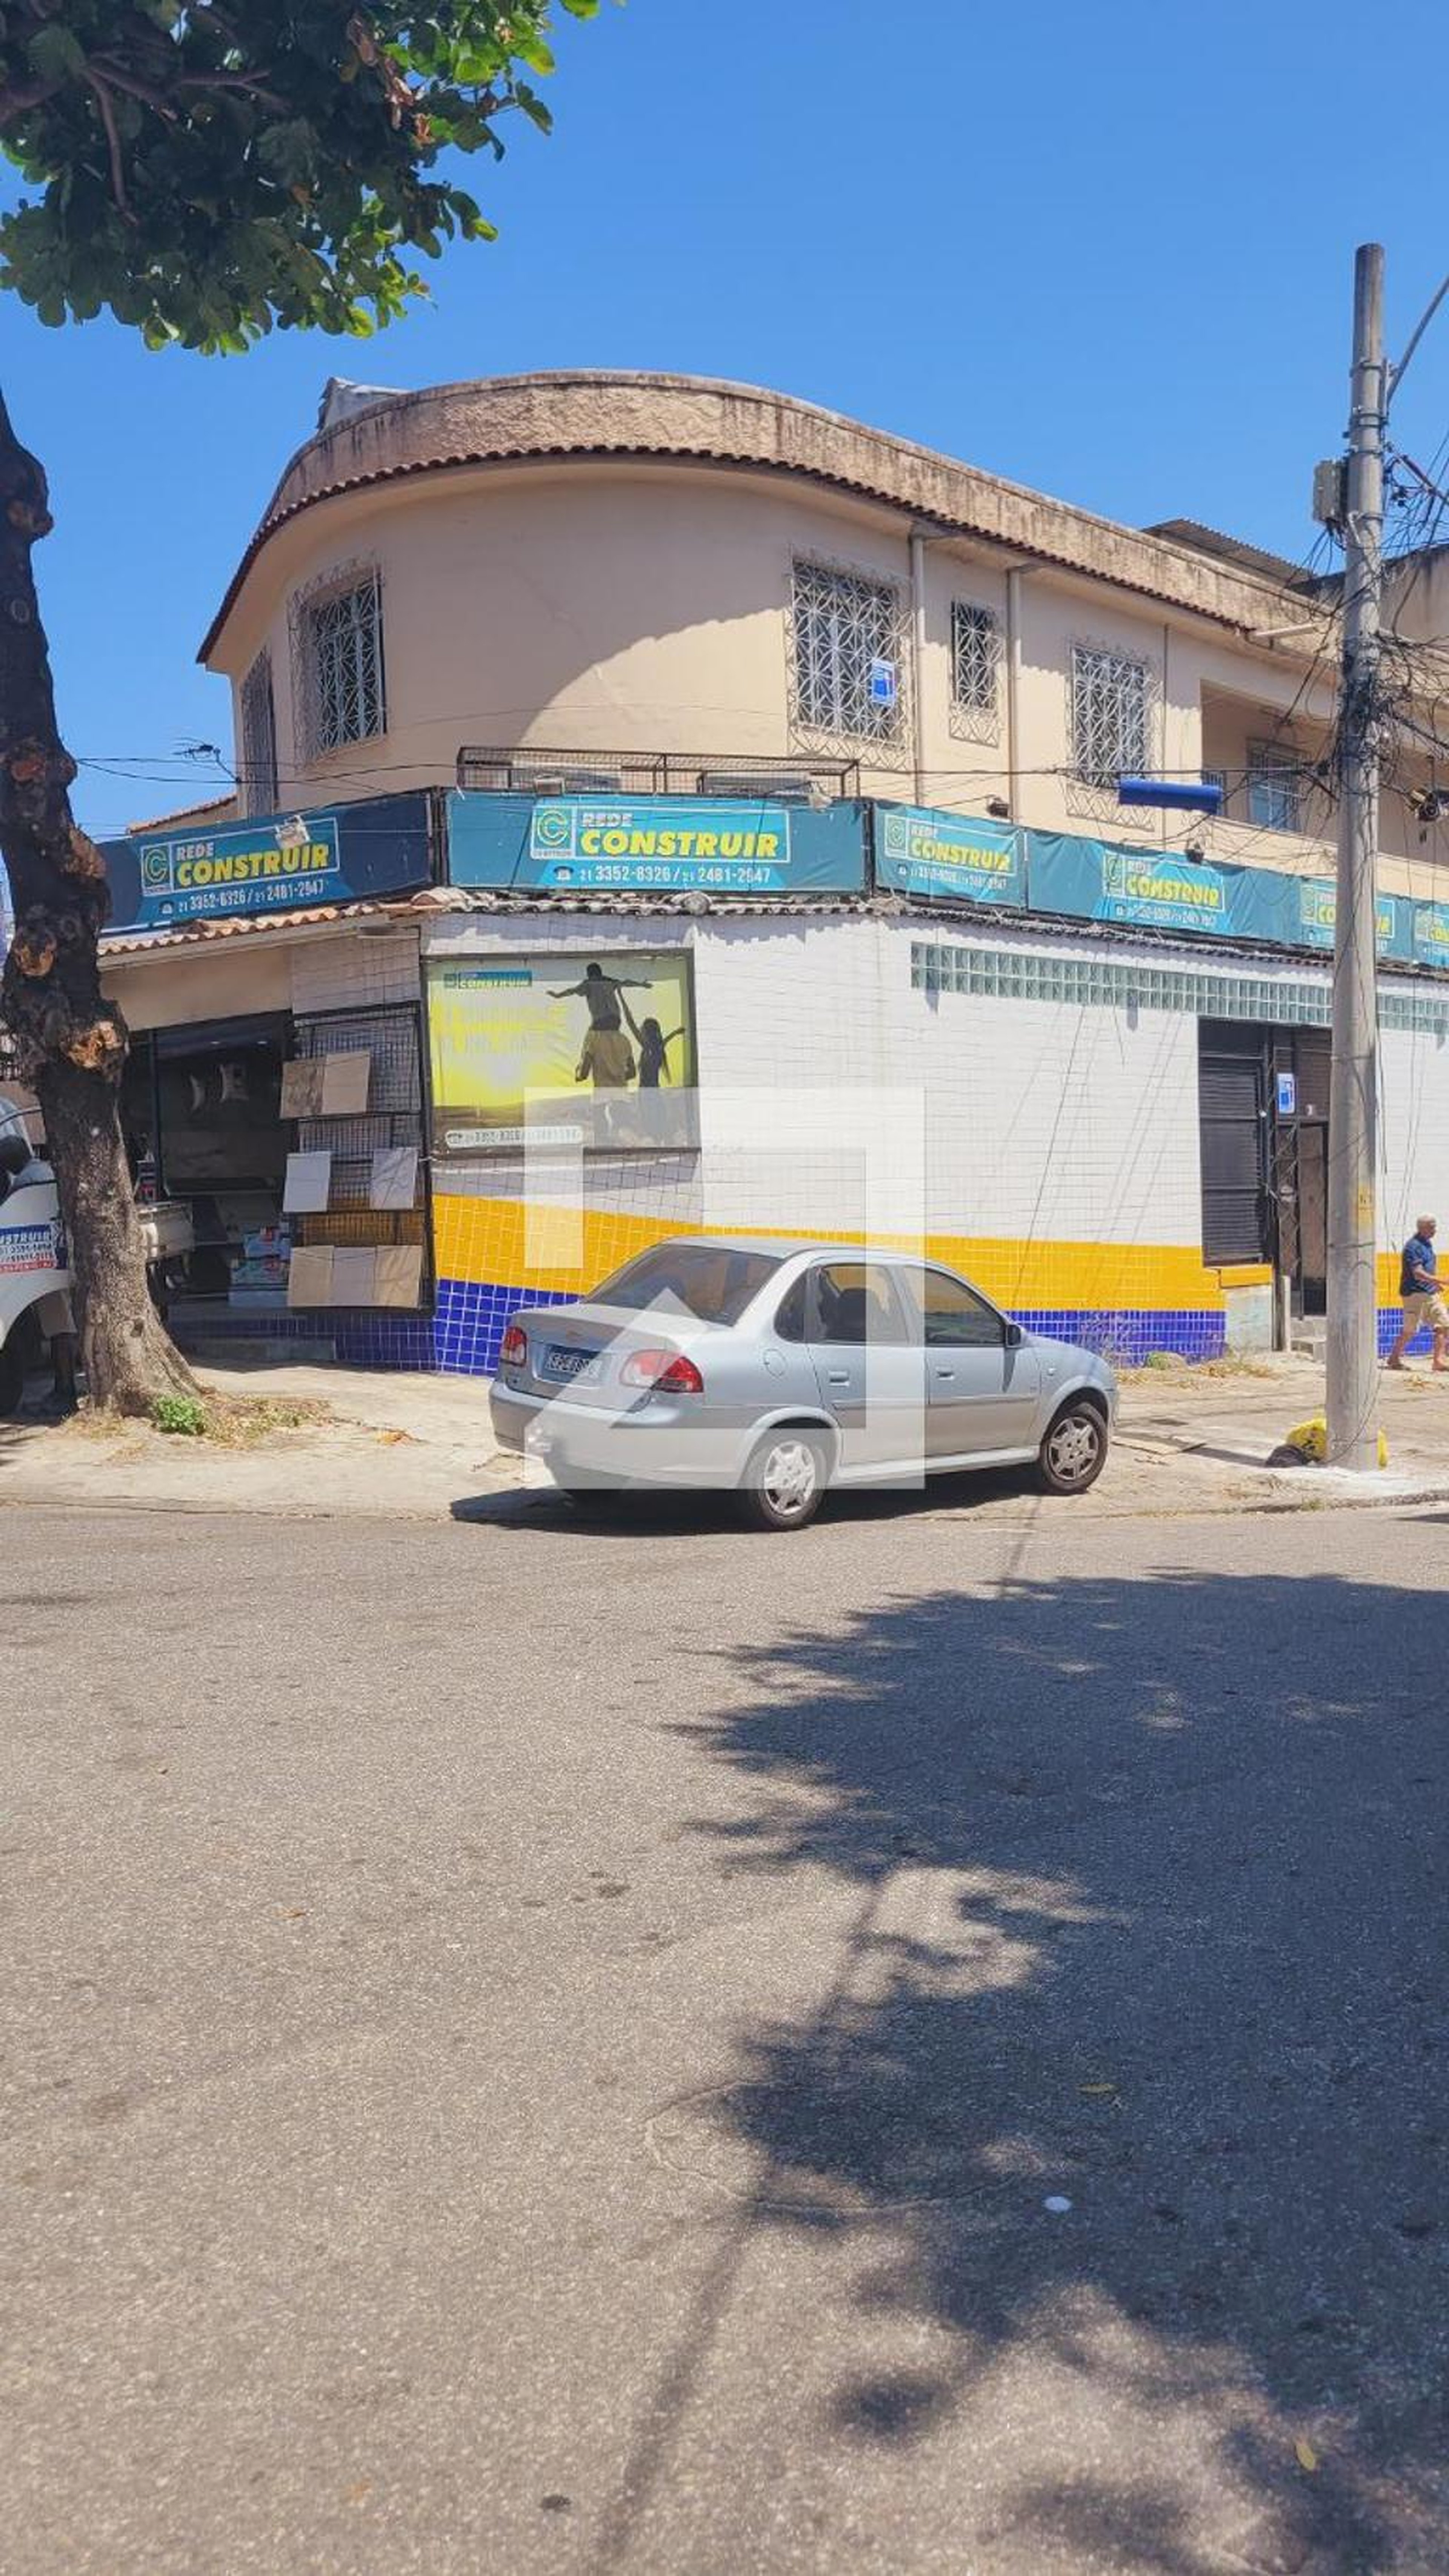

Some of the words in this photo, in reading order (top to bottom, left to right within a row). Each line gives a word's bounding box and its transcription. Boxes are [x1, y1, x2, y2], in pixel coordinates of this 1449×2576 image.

[176, 842, 214, 861] REDE
[580, 829, 778, 858] CONSTRUIR
[911, 836, 1011, 871] CONSTRUIR
[177, 844, 329, 887] CONSTRUIR
